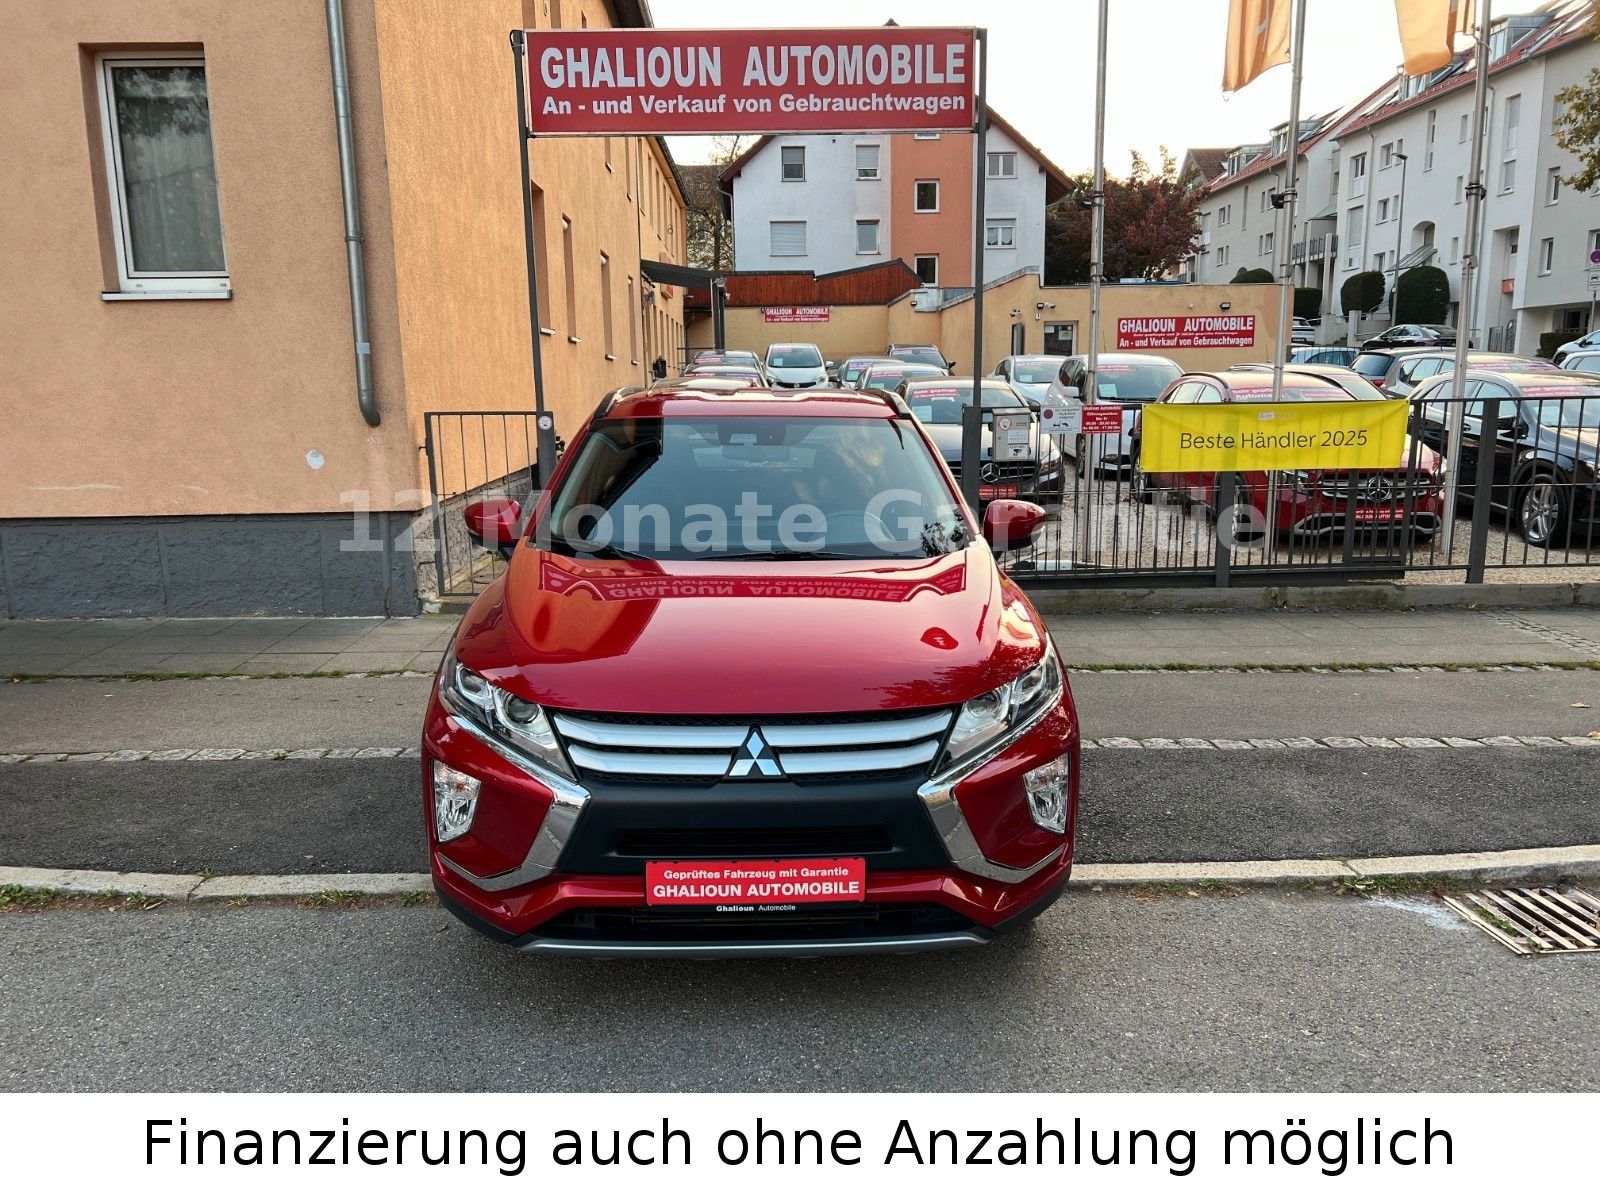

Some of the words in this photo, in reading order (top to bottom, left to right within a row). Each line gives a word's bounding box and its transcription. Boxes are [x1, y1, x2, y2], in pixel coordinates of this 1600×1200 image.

[540, 46, 722, 89] GHALIOUN
[743, 43, 966, 87] AUTOMOBILE
[542, 96, 572, 115] An
[592, 94, 633, 115] und
[639, 93, 727, 115] Verkauf
[733, 97, 772, 114] von
[778, 92, 966, 115] Gebrauchtwagen
[796, 307, 829, 315] AUTOMOBILE
[1119, 318, 1176, 333] GHALIOUN
[1183, 317, 1254, 332] AUTOMOBILE
[1119, 338, 1129, 347] An
[1135, 338, 1148, 347] und
[1149, 337, 1177, 347] Verkauf
[1193, 336, 1252, 347] Gebrauchtwagen
[1180, 433, 1235, 449] Beste
[1241, 431, 1316, 449] Händler
[1321, 430, 1368, 447] 2025
[664, 869, 720, 880] Geprüftes
[723, 869, 776, 880] Fahrzeug
[778, 868, 797, 877] mit
[800, 867, 849, 877] Garantie
[653, 884, 742, 898] GHALIOUN
[746, 881, 860, 897] AUTOMOBILE
